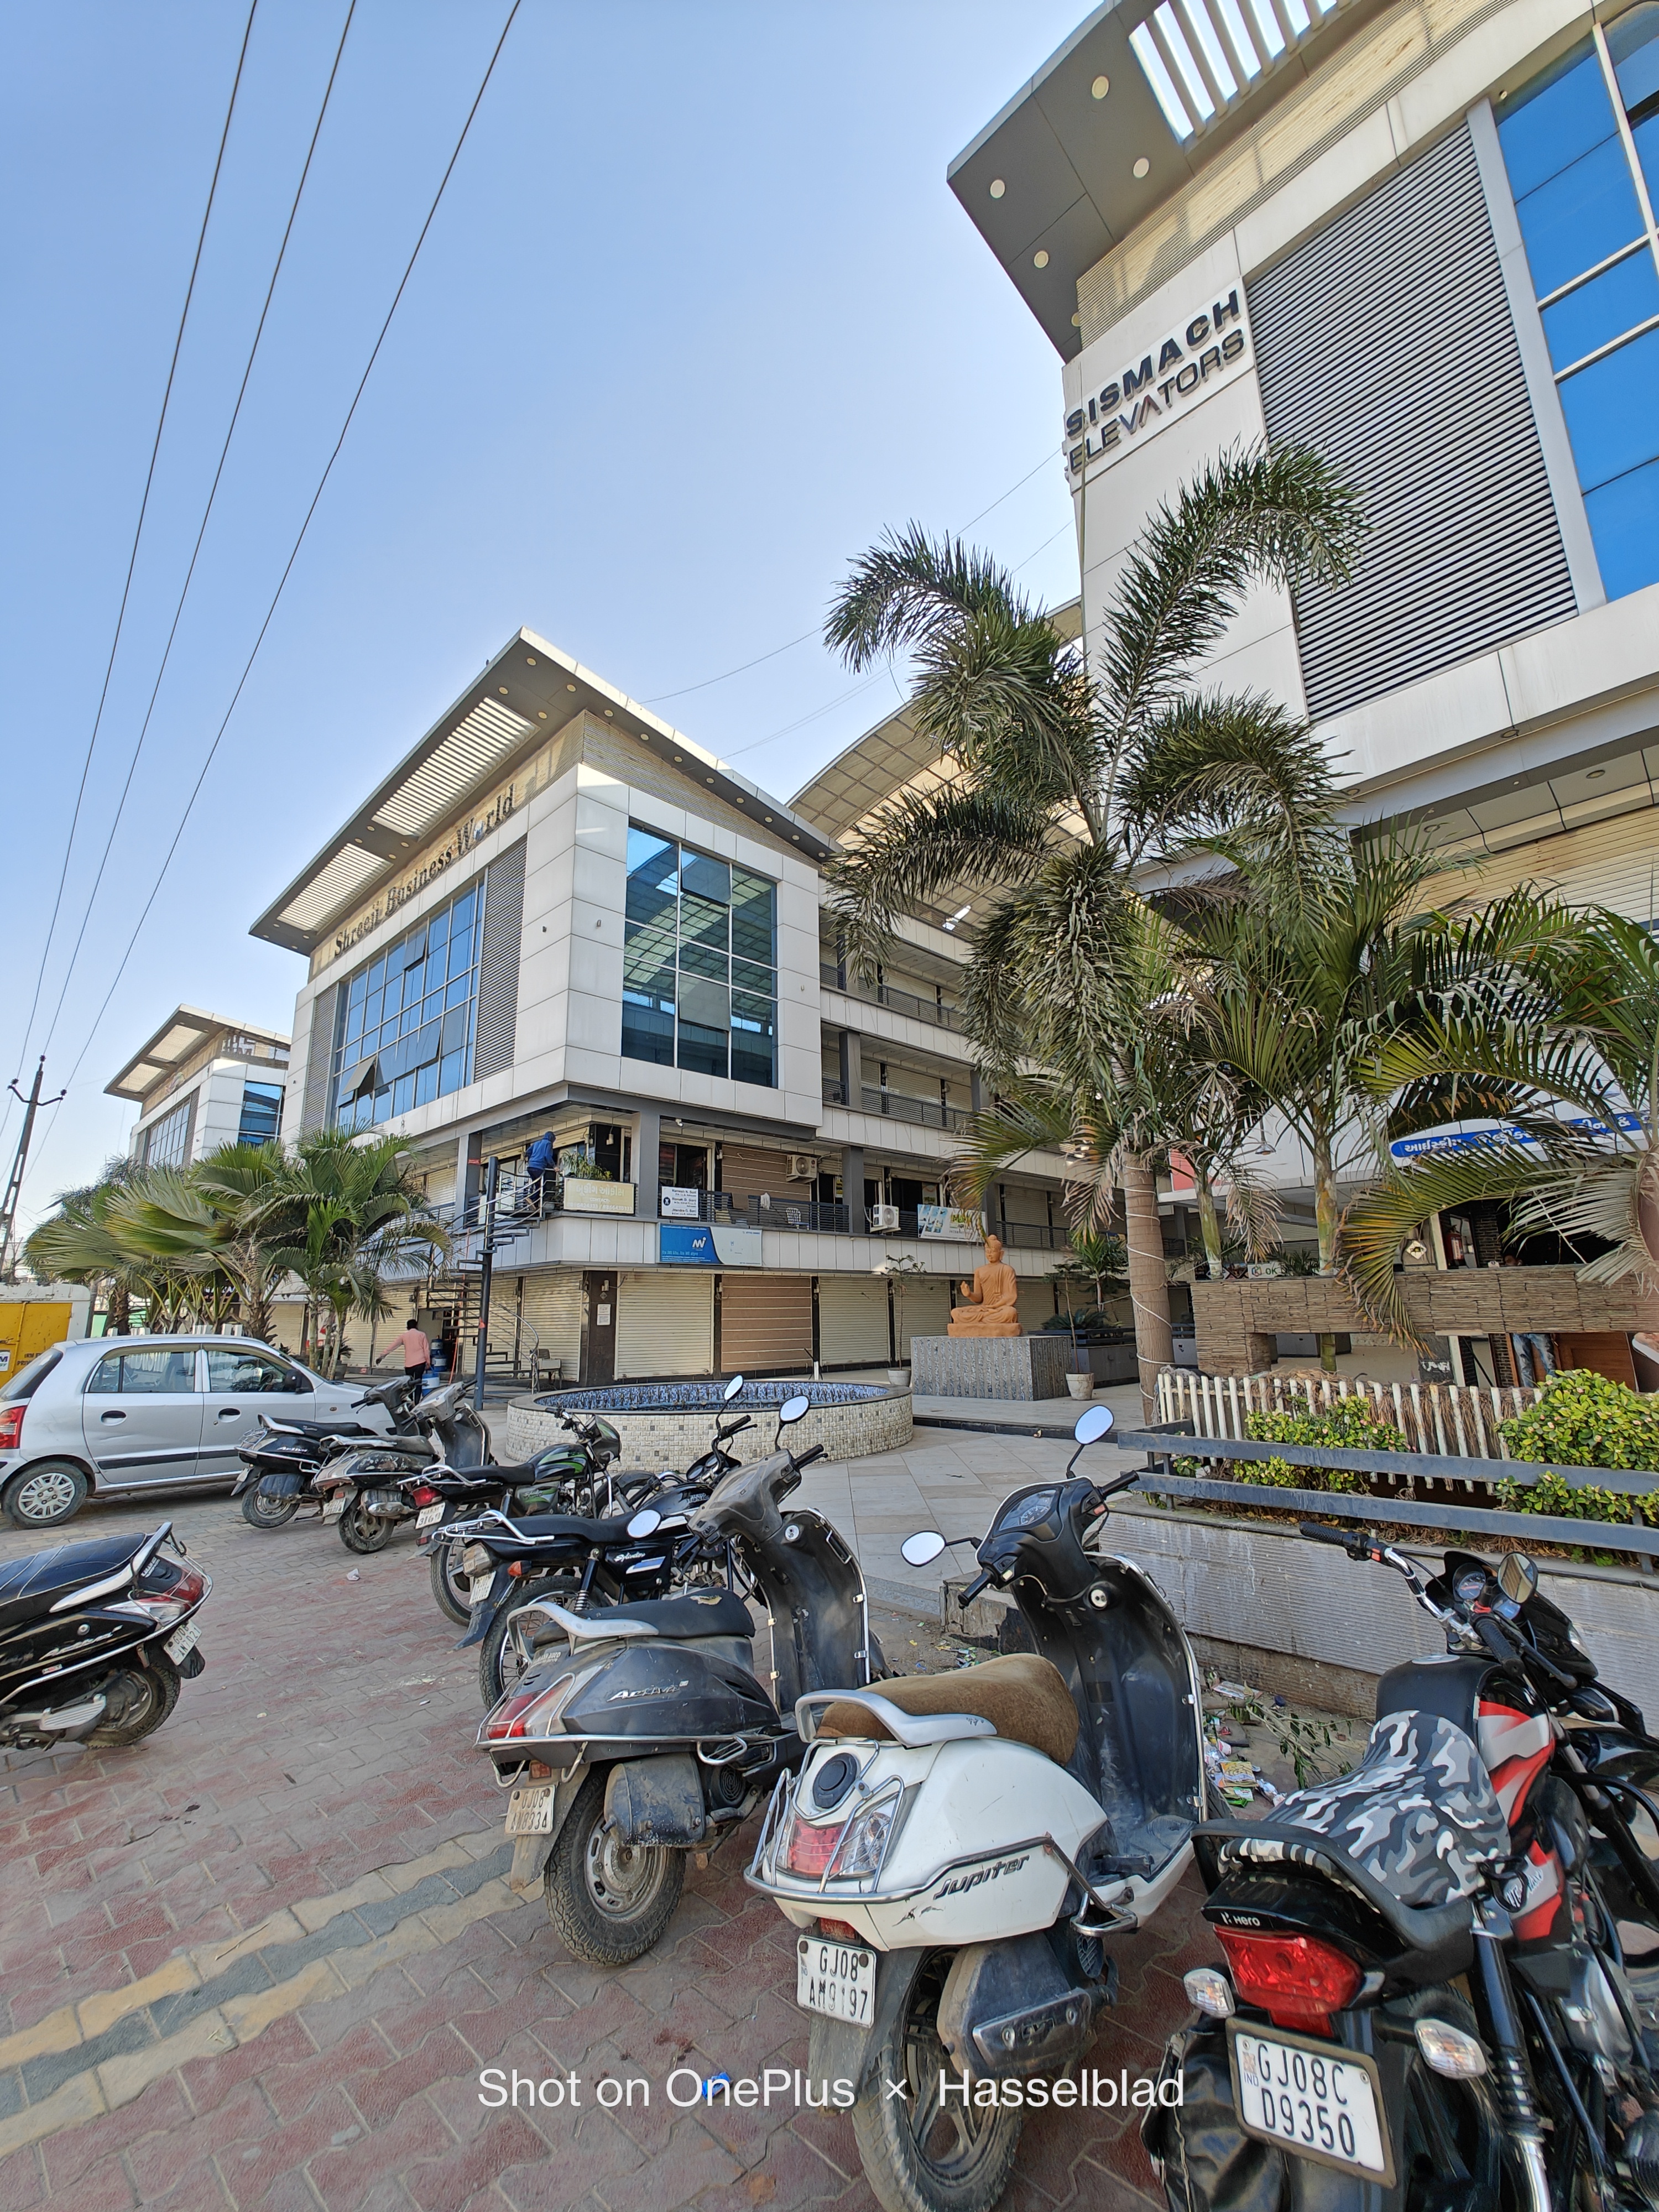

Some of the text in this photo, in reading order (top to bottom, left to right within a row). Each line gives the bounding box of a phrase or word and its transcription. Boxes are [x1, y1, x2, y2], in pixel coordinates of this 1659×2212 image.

[1066, 289, 1241, 440] SISMACH
[1069, 328, 1246, 476] ELEVATORS
[932, 1854, 1030, 1901] Jupiter
[1232, 1915, 1261, 1927] Hero
[820, 1945, 859, 1982] GJ08
[1244, 2072, 1259, 2087] IND
[1258, 2043, 1348, 2105] GJ08C
[1261, 2087, 1356, 2157] D9350
